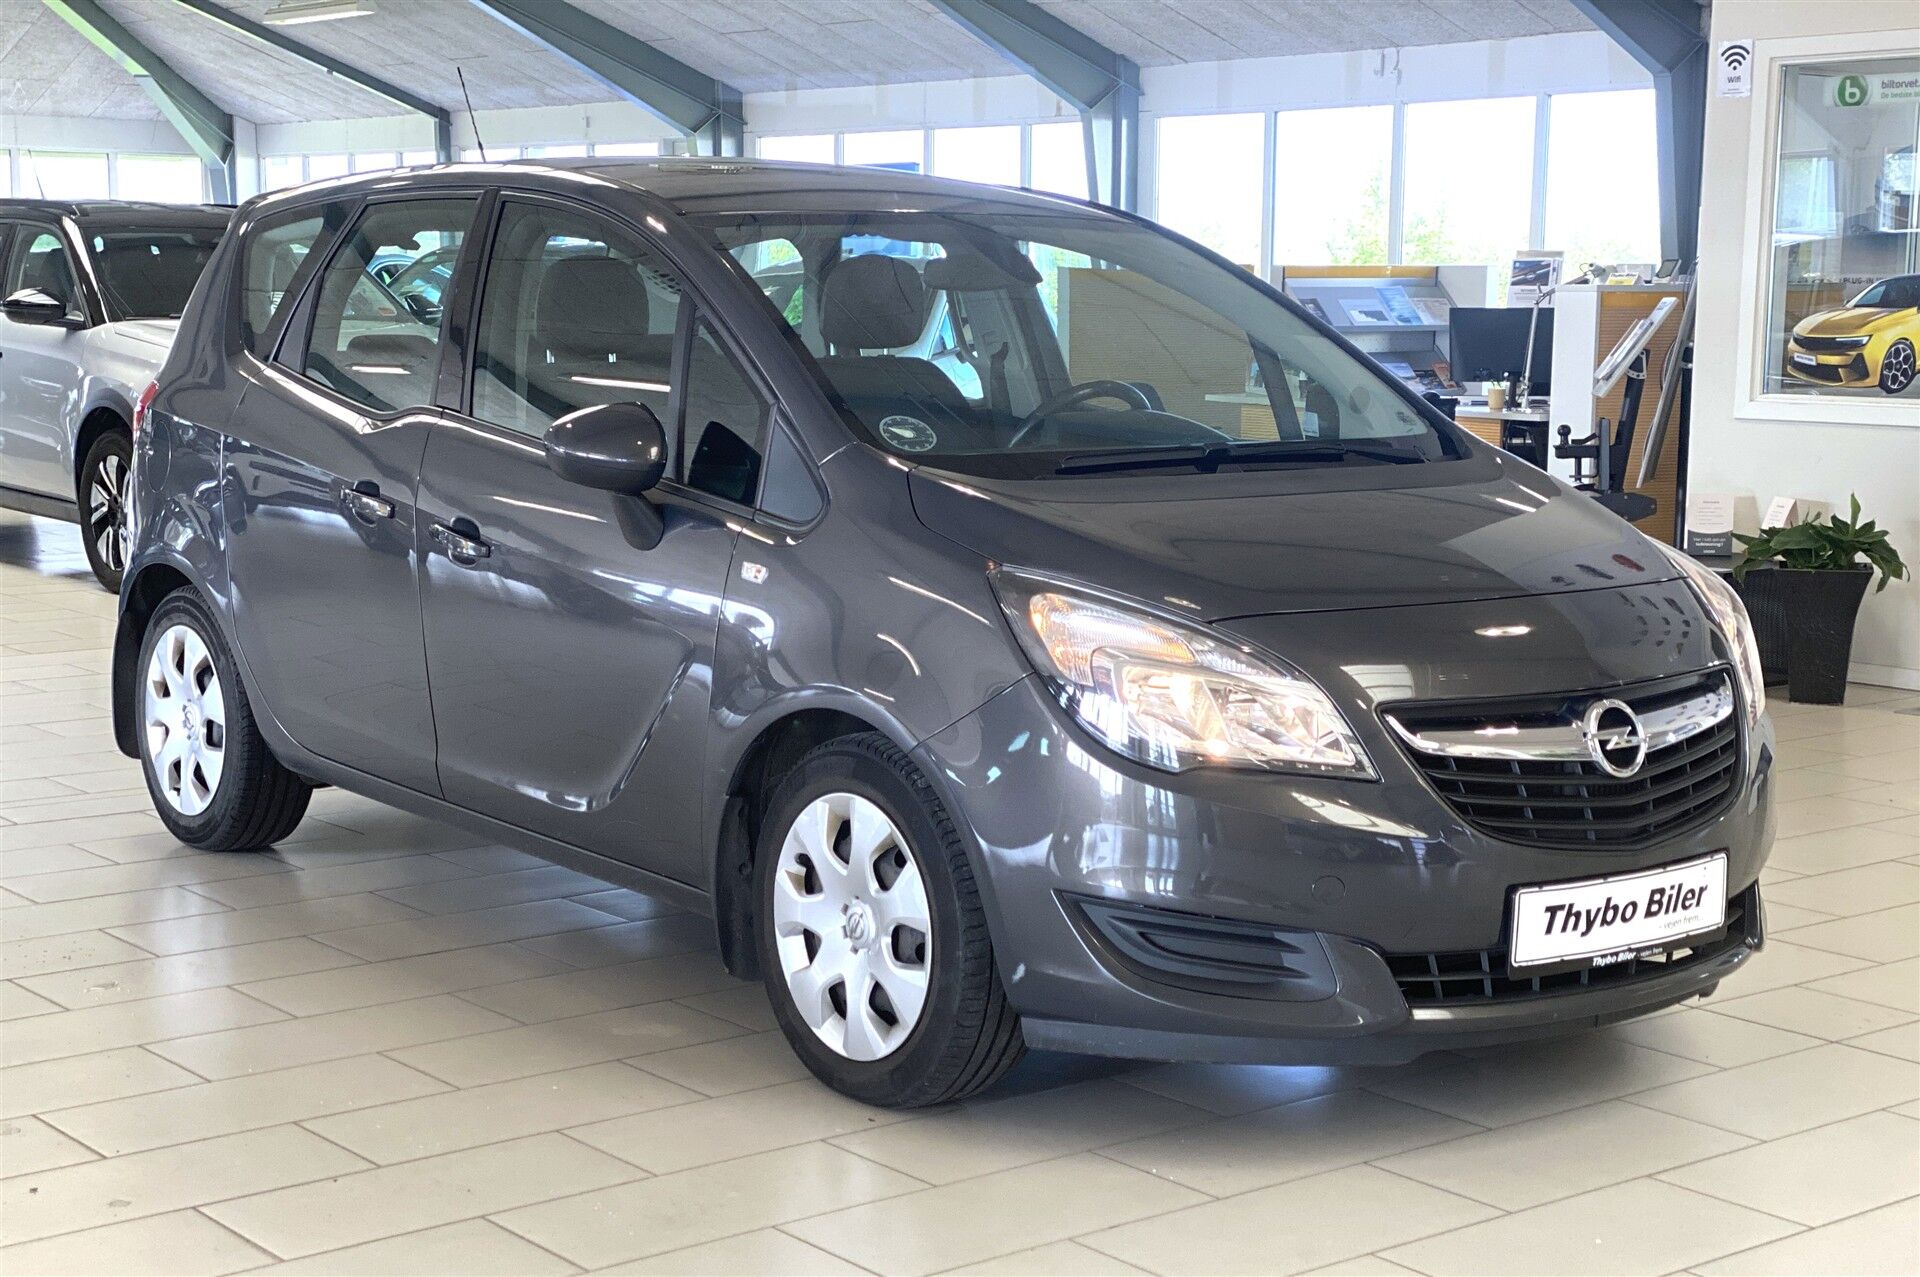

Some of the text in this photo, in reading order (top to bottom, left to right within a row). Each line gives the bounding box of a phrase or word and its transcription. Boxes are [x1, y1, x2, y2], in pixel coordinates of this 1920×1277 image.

[1544, 883, 1708, 937] Thybo Biler
[1593, 955, 1617, 967] Thybo
[1617, 951, 1637, 962] Biler
